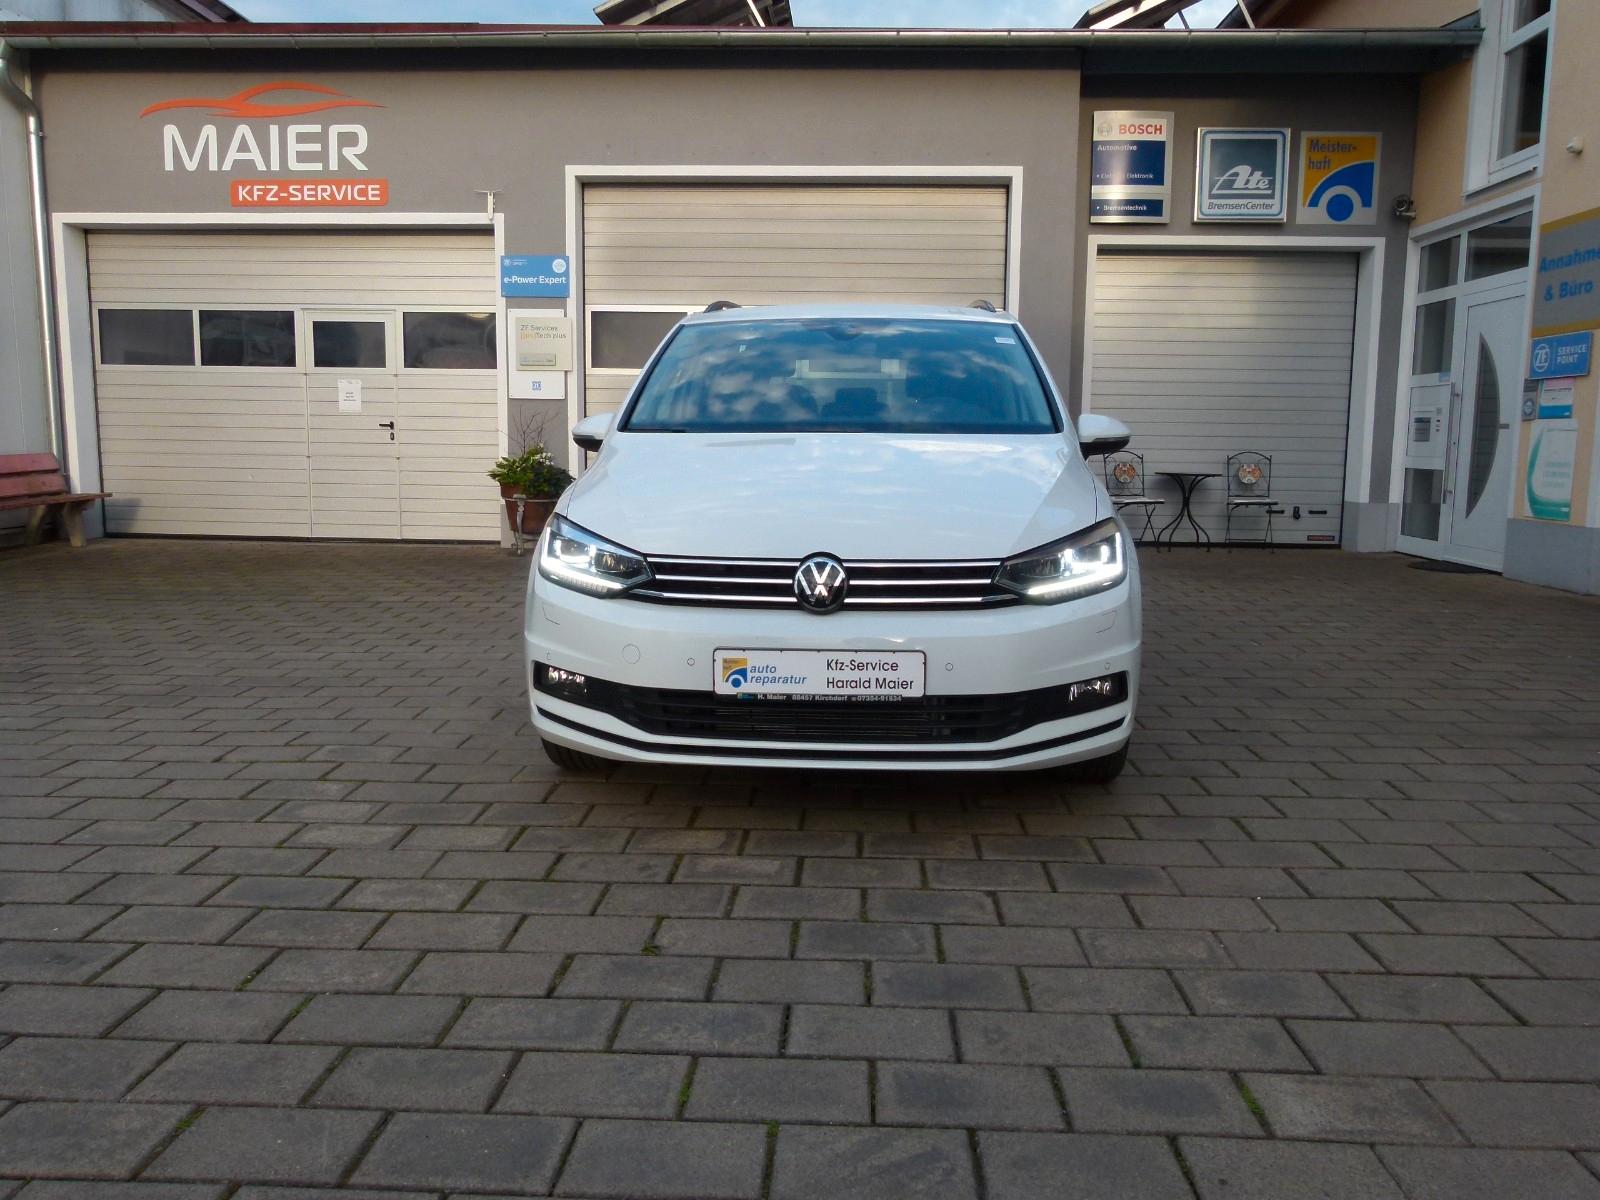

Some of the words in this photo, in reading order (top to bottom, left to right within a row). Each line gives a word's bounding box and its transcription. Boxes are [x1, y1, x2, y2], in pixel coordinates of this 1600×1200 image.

[1118, 124, 1163, 136] BOSCH
[163, 124, 369, 172] MAIER
[1097, 143, 1138, 152] Automotive
[1308, 139, 1357, 153] Meister-
[1308, 157, 1331, 171] haft
[238, 184, 381, 202] KFZ-SERVICE
[1103, 203, 1148, 212] Bremsentechnik
[1207, 201, 1275, 211] BremsenCenter
[503, 274, 538, 285] e-Power
[539, 275, 567, 286] Expert
[1544, 284, 1553, 302] &
[1559, 279, 1594, 299] Büro
[530, 324, 558, 332] Services
[1557, 344, 1588, 356] SERVICE
[1535, 349, 1549, 367] ZF
[1556, 354, 1579, 365] POINT
[750, 665, 777, 674] auto
[826, 659, 899, 672] Kfz-Service
[750, 675, 807, 686] reparatur
[826, 677, 871, 690] Harald
[875, 677, 914, 690] Maier
[815, 694, 848, 702] Kirchdorf
